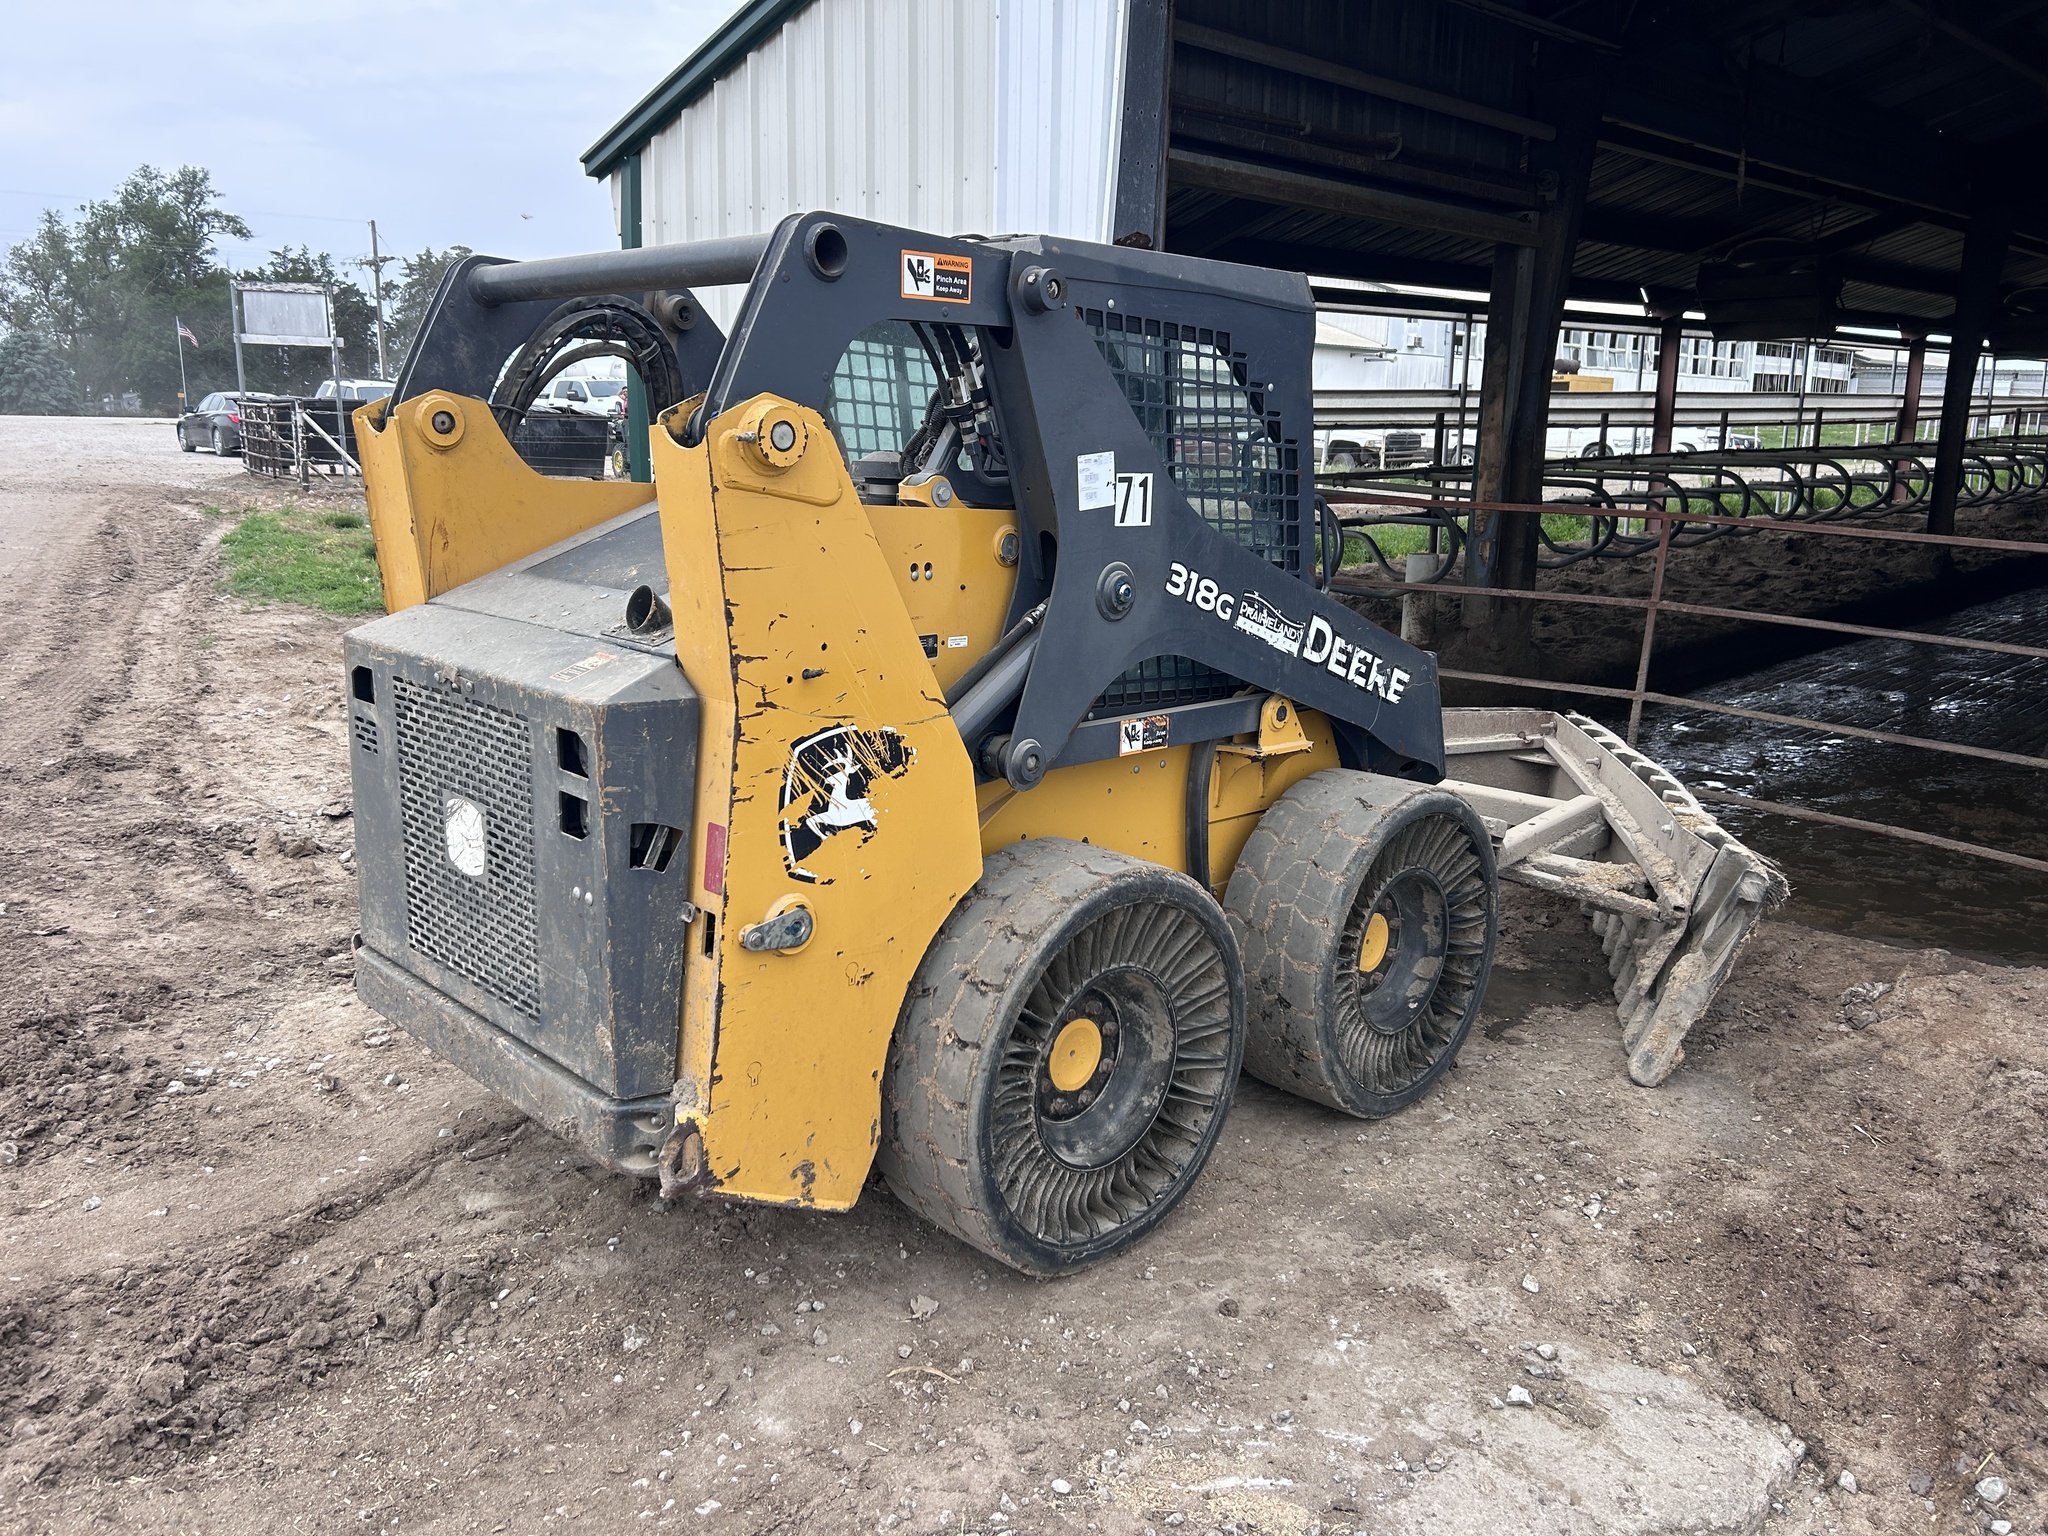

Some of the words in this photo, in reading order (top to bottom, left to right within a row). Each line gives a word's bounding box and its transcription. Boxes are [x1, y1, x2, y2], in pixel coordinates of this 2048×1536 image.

[943, 260, 969, 269] WARNING
[936, 275, 953, 284] Pinch
[953, 277, 967, 285] Area
[936, 285, 949, 293] Keep
[949, 287, 963, 295] Away
[1118, 476, 1149, 523] 71
[1165, 562, 1235, 621] 318G
[1303, 615, 1411, 705] DEERE
